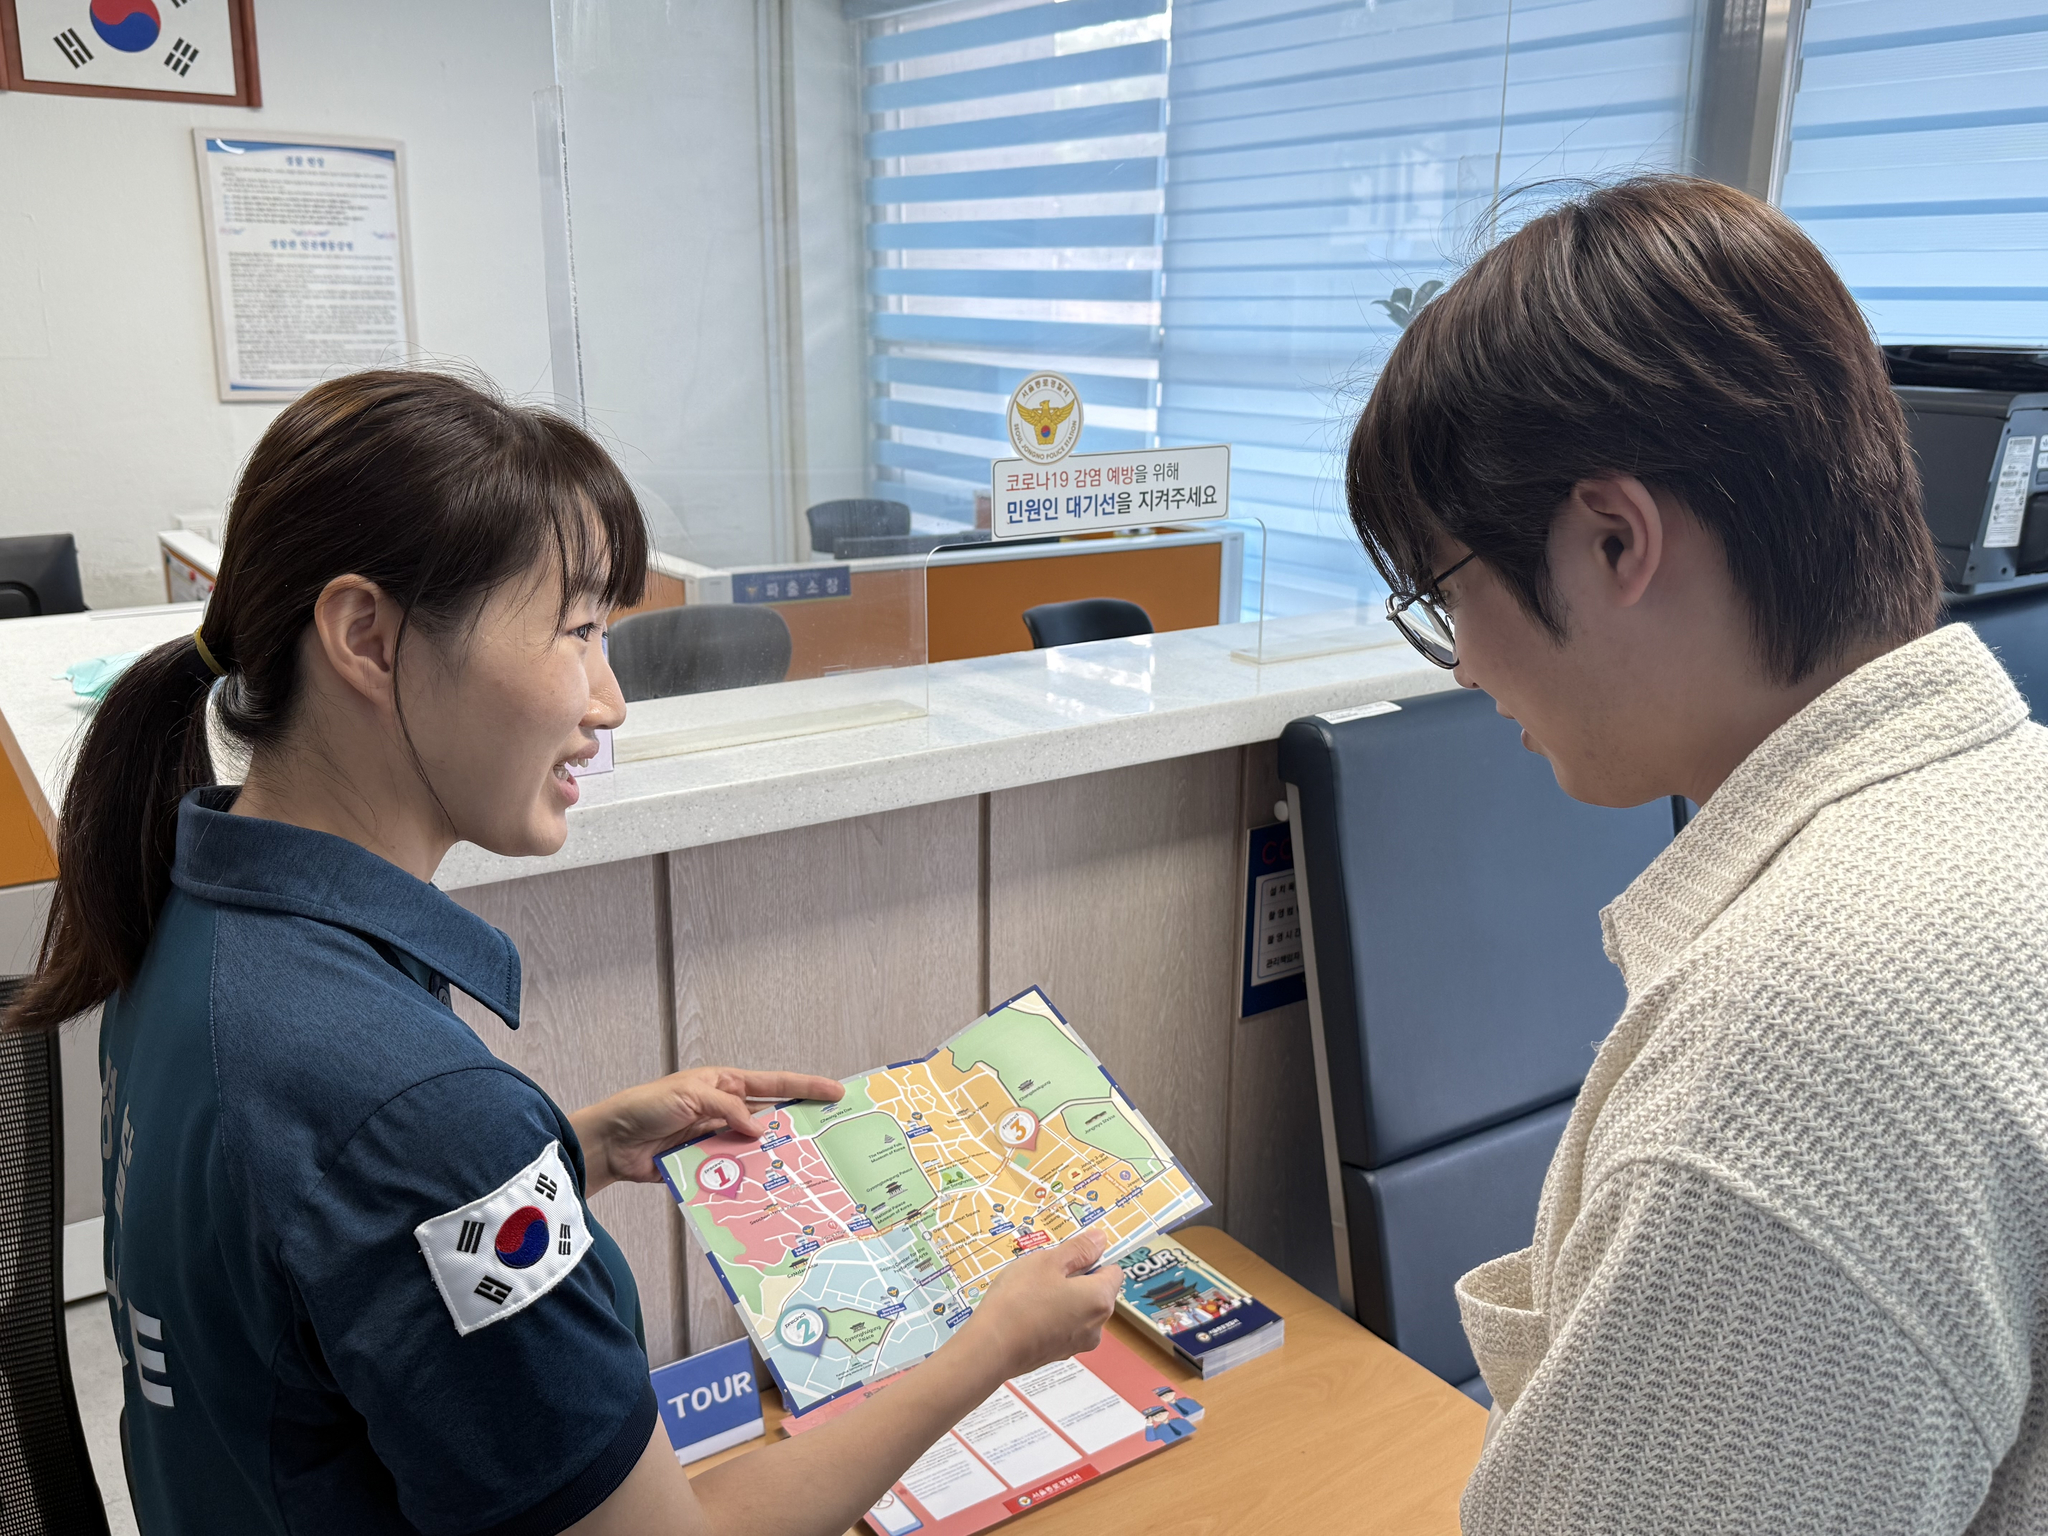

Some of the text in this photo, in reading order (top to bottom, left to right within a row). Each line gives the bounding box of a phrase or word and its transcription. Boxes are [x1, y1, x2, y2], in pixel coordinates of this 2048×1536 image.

[1021, 379, 1070, 399] 서울종로경찰서
[1013, 420, 1077, 461] SEOUL JONGNO POLICE STATION
[1006, 462, 1180, 492] 코로나19 감염 예방을 위해
[1007, 485, 1218, 524] 민원인 대기선을 지켜주세요
[1268, 904, 1299, 921] 촬영범
[1010, 1118, 1027, 1141] 3
[714, 1166, 731, 1188] 1
[1122, 1249, 1177, 1279] TOUR
[796, 1318, 817, 1345] 2
[667, 1371, 753, 1418] TOUR
